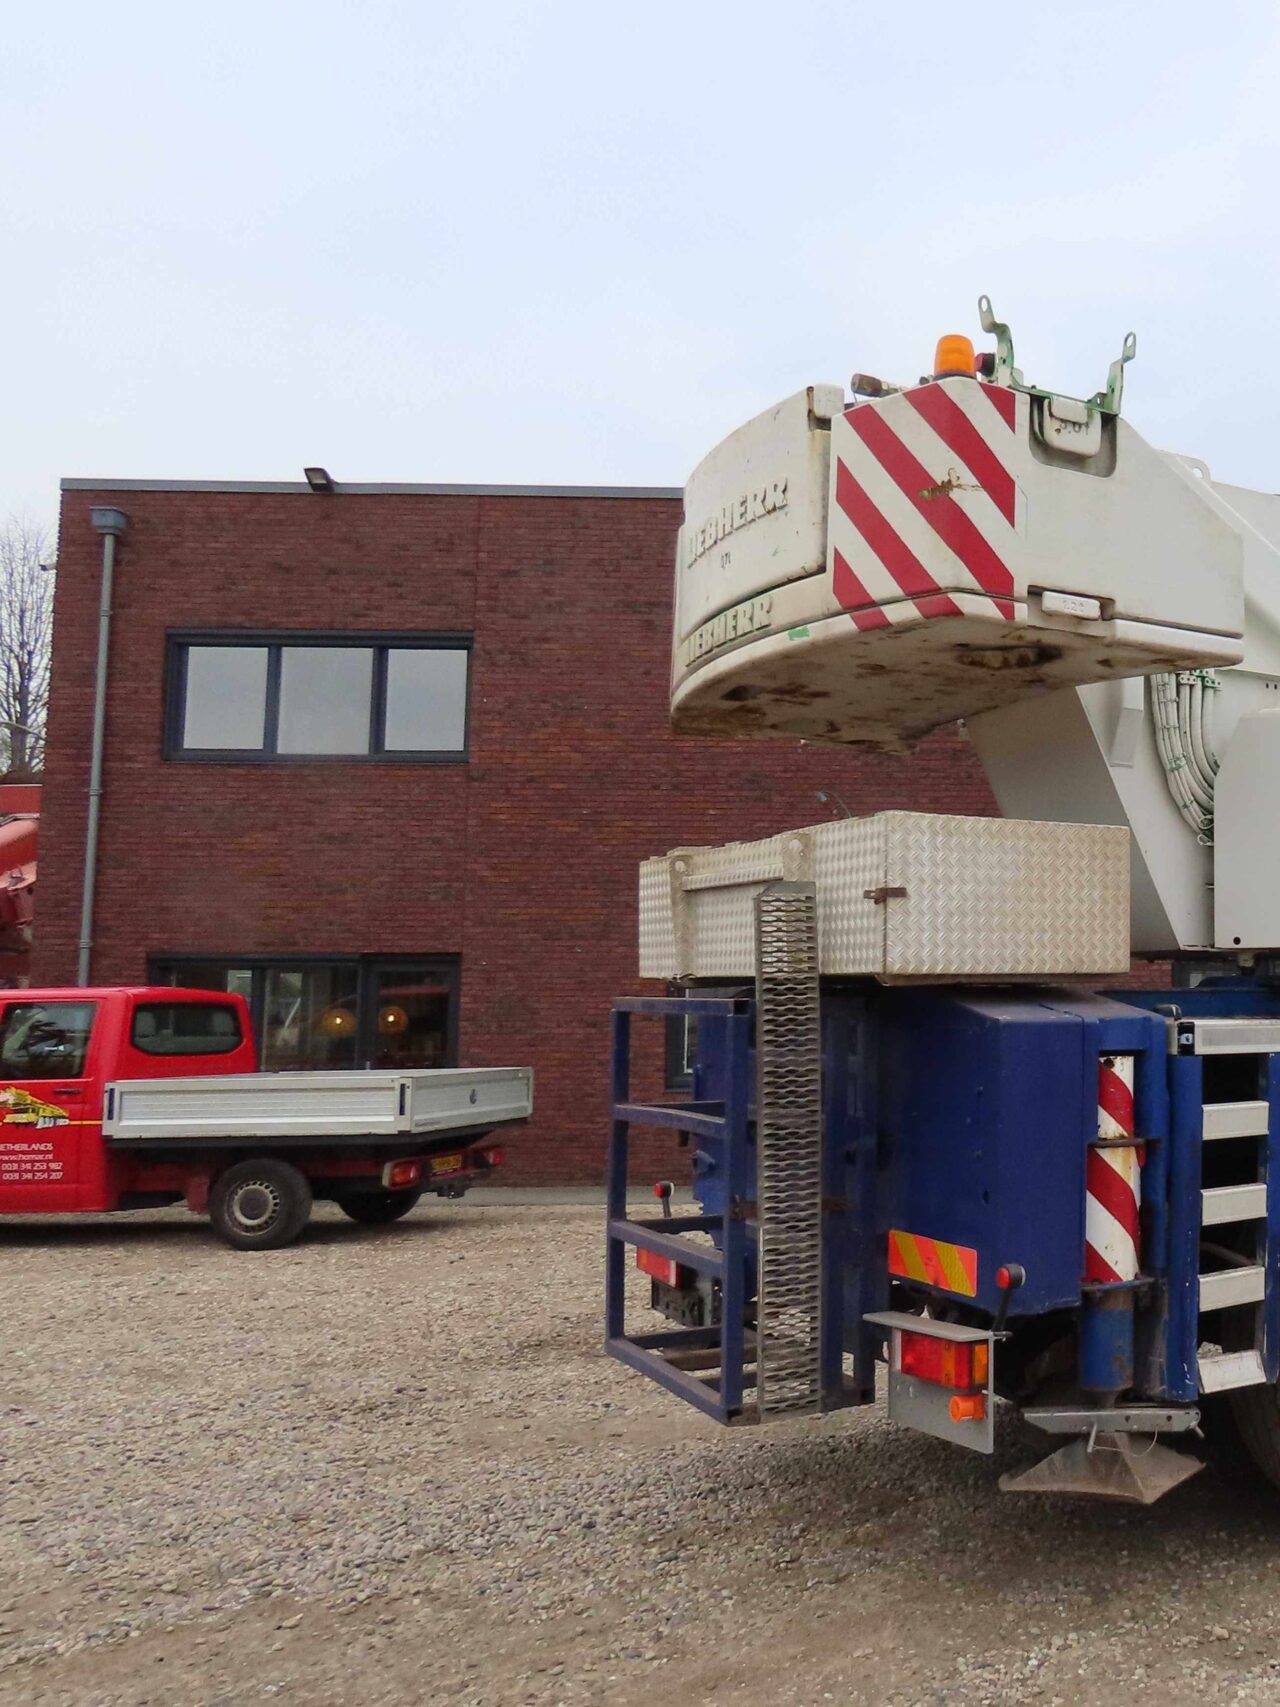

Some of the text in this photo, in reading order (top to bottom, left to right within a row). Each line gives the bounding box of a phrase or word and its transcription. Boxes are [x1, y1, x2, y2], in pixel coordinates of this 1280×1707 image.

[687, 477, 788, 569] LIEBHERR
[684, 595, 773, 668] LIEBHERR
[1, 1162, 18, 1170] 0031
[33, 1162, 47, 1170] 253
[2, 1172, 19, 1180] 0031
[34, 1172, 48, 1180] 254
